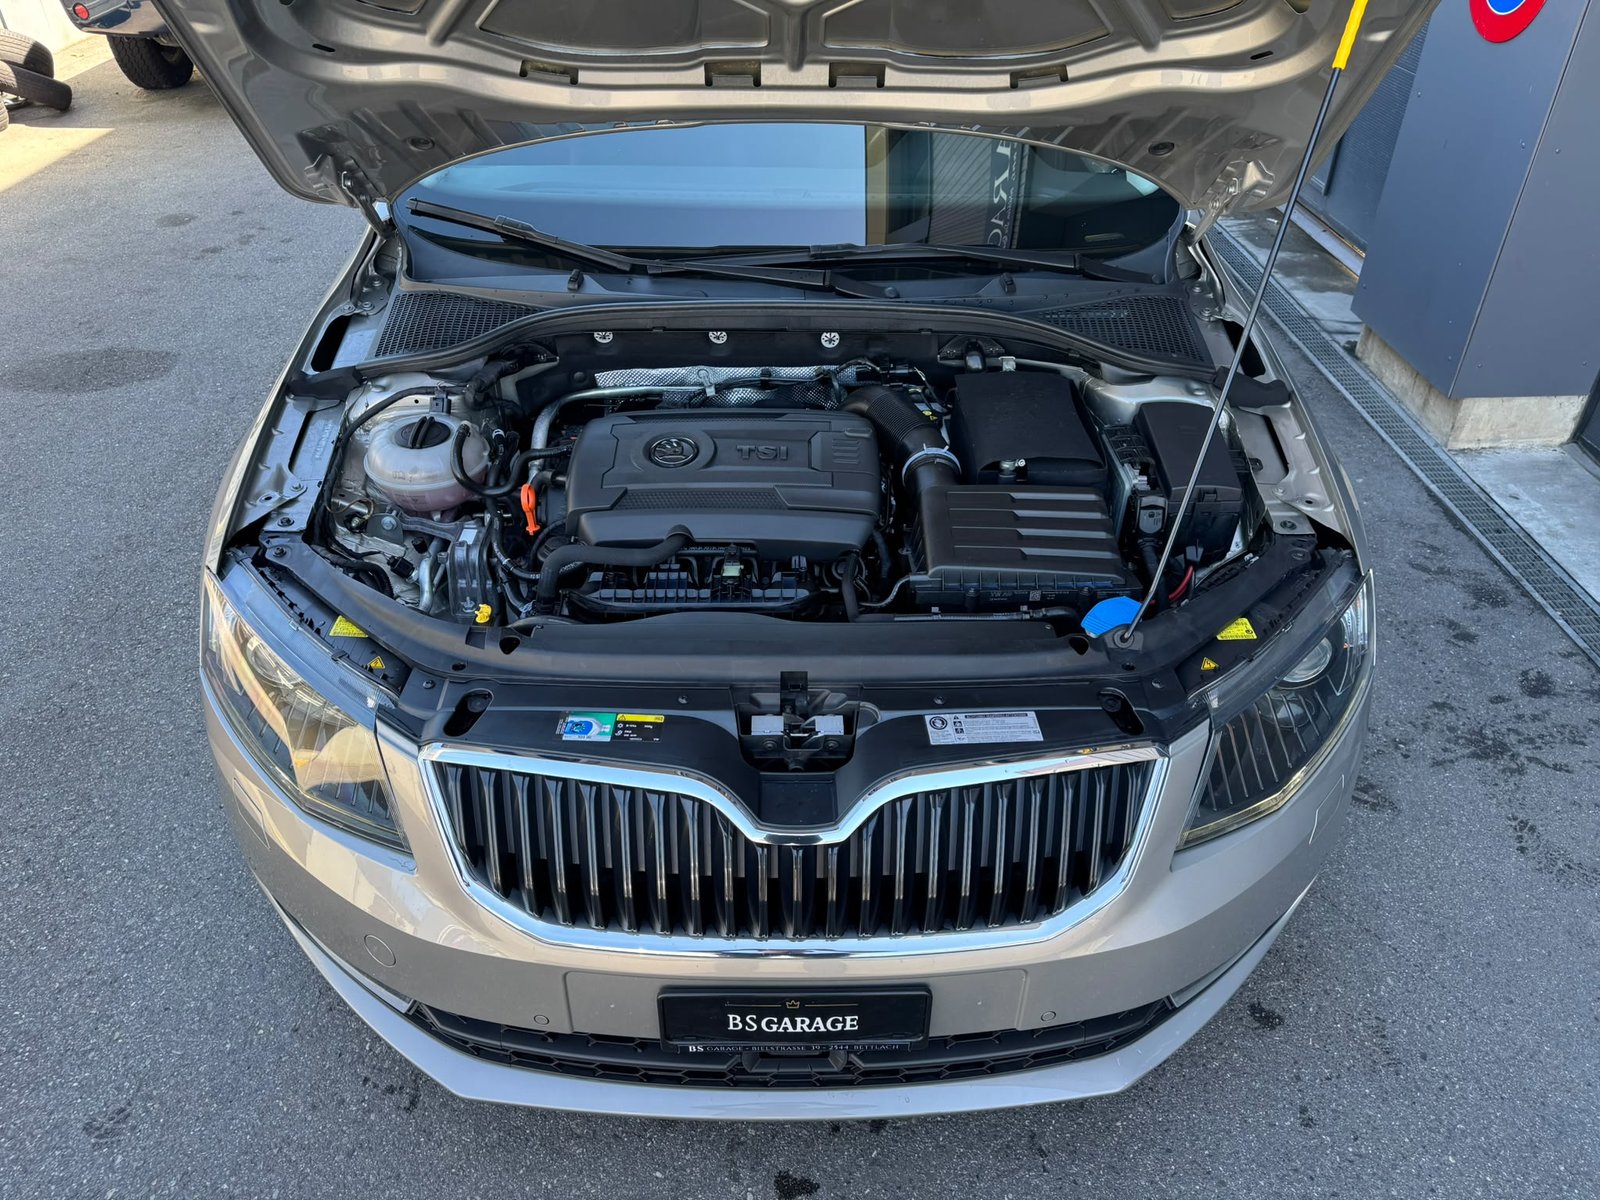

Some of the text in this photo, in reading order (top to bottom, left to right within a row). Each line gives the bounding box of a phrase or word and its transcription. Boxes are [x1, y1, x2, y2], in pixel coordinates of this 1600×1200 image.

[736, 445, 788, 460] TSI
[727, 1014, 859, 1032] BS GARAGE
[688, 1045, 704, 1053] BS
